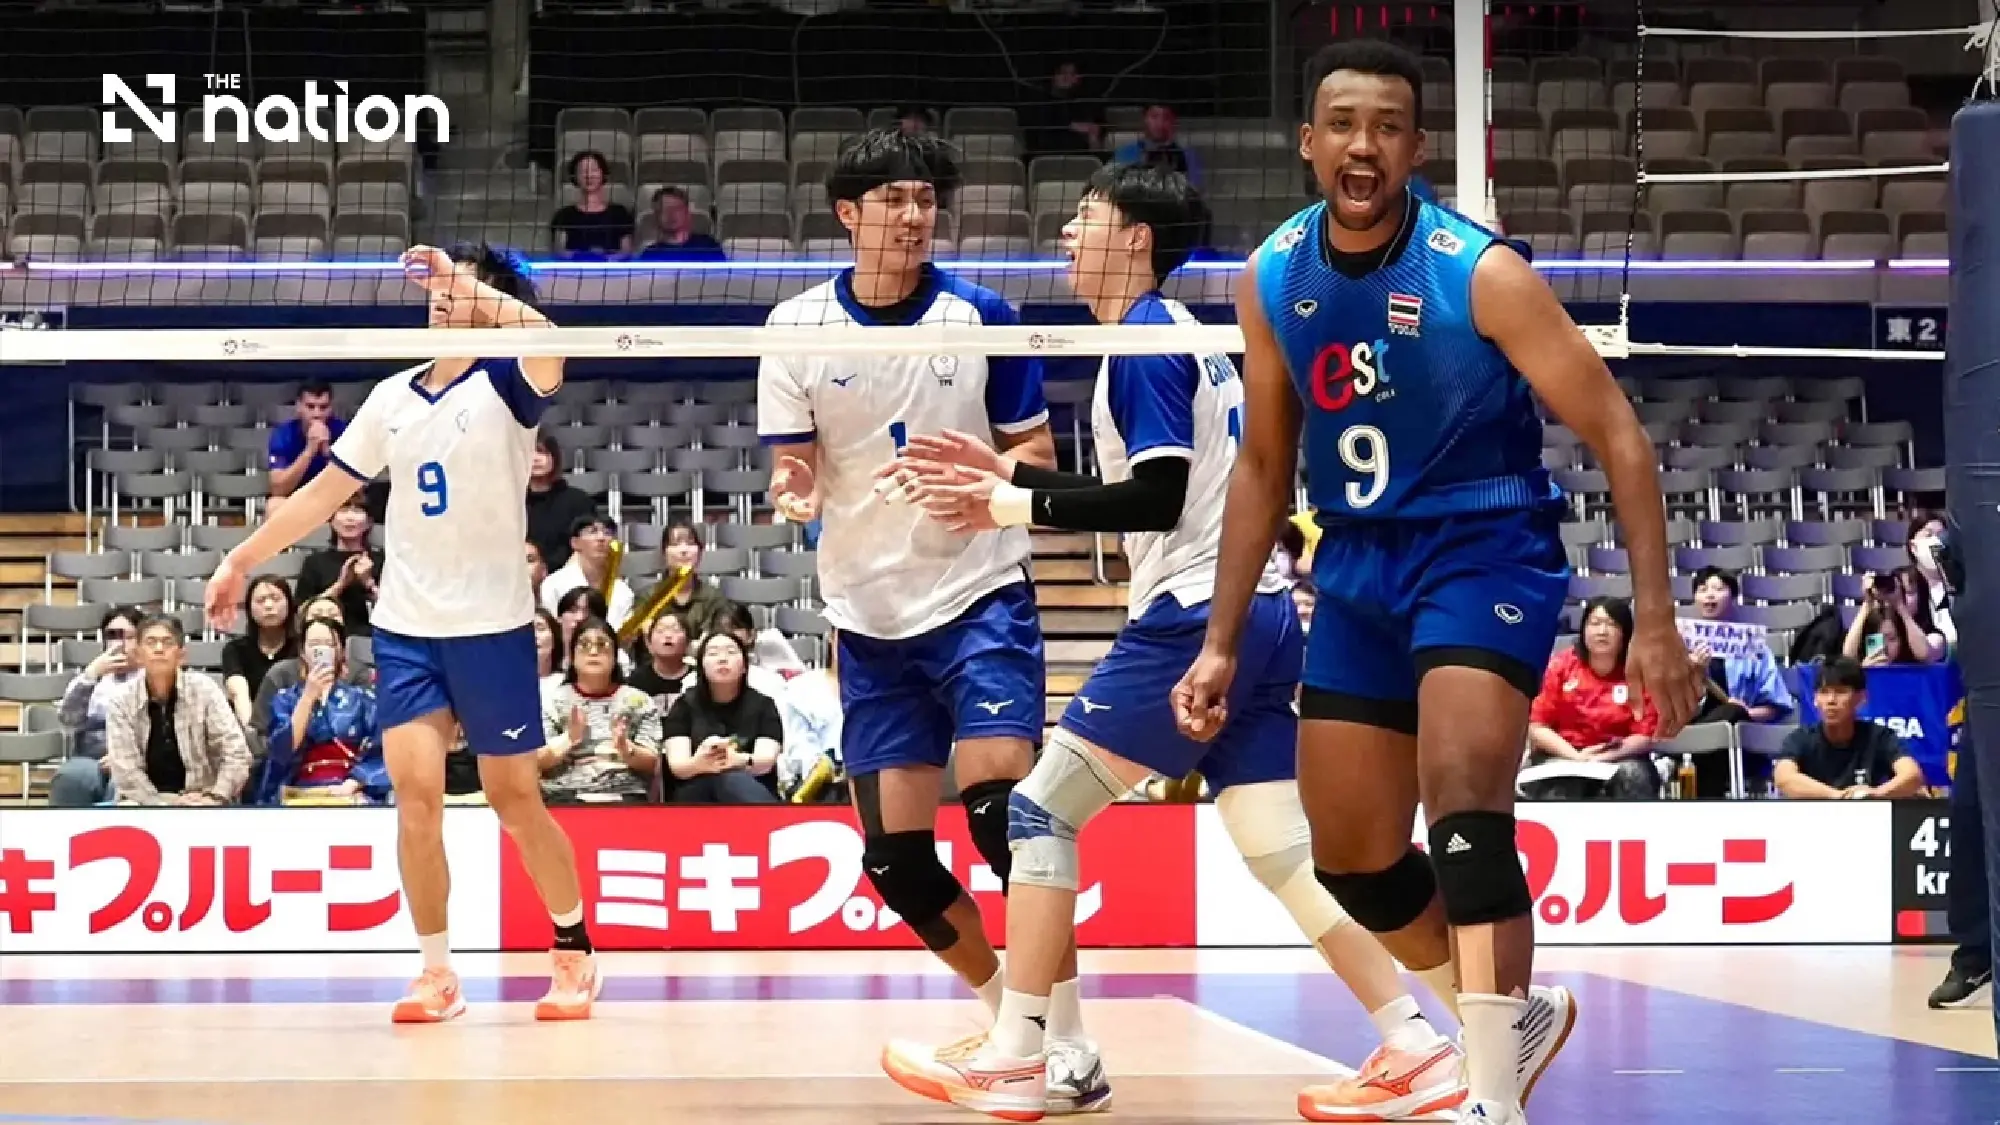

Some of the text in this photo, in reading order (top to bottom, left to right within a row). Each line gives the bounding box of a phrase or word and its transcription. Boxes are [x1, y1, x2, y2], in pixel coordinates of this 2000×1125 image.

[1312, 338, 1391, 411] est
[417, 461, 448, 516] 9
[1338, 425, 1390, 509] 9
